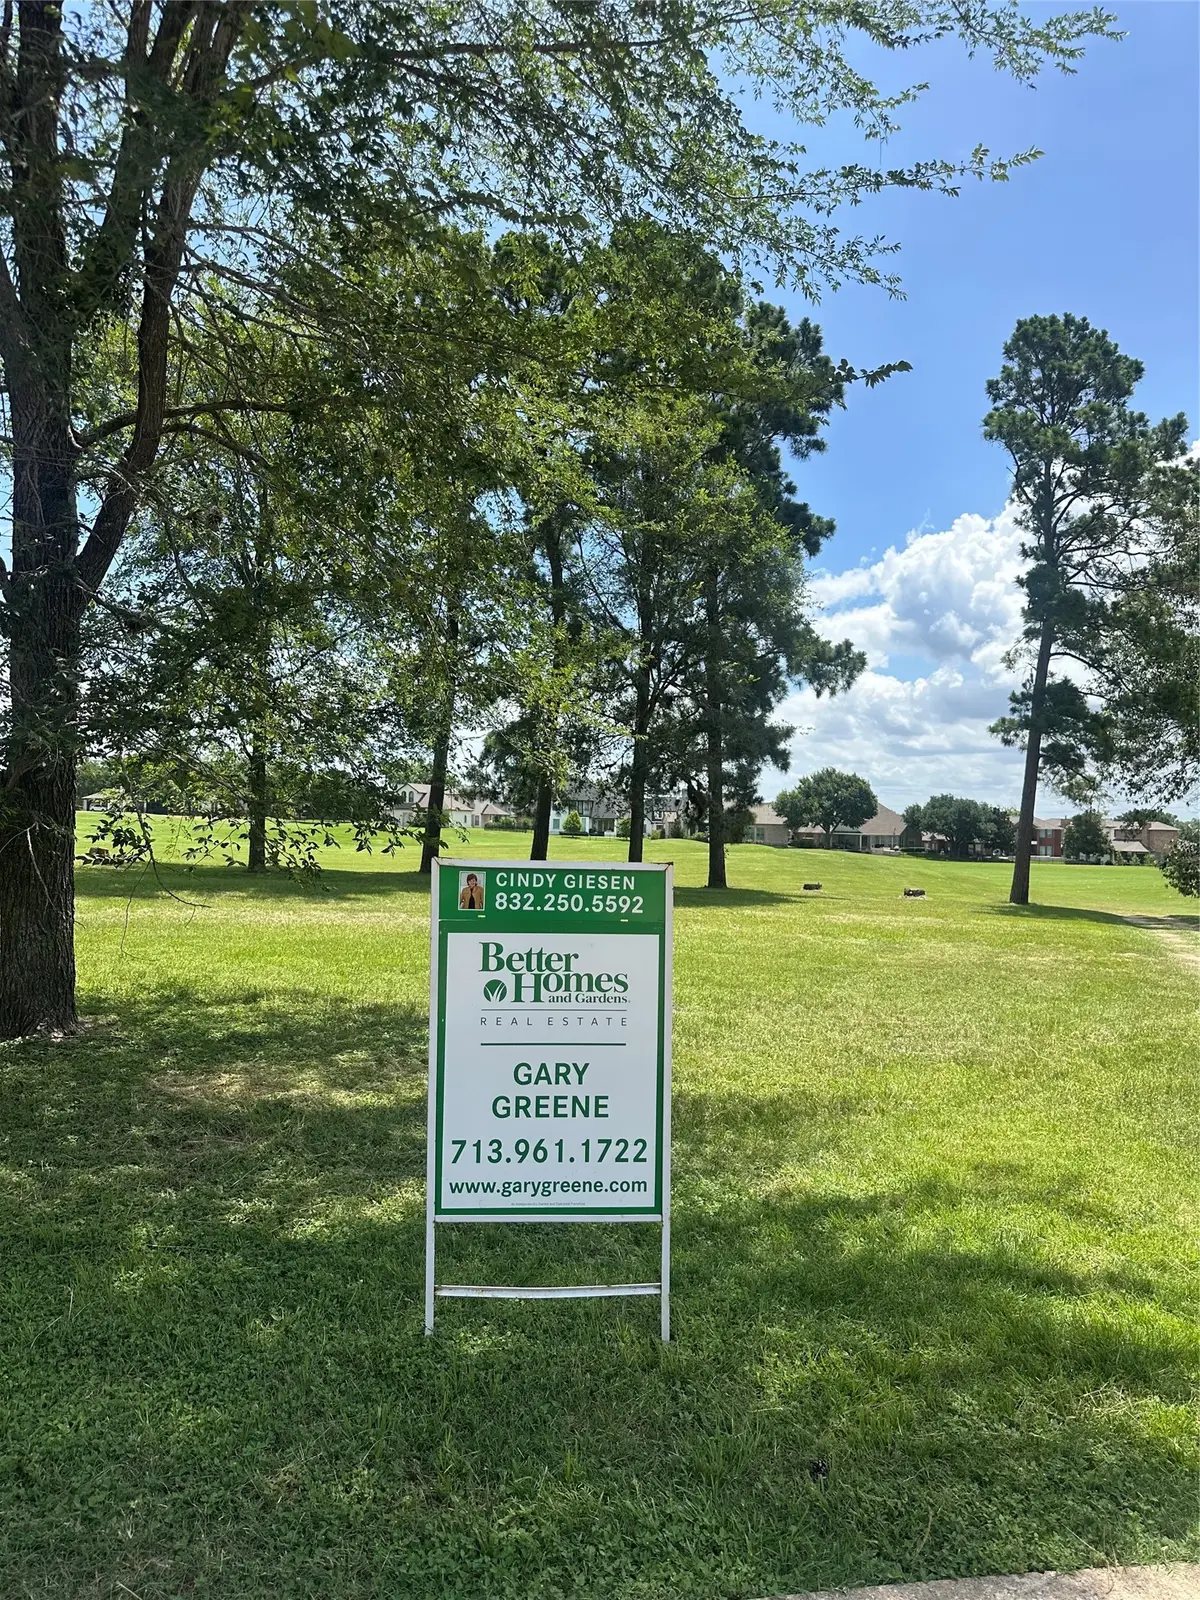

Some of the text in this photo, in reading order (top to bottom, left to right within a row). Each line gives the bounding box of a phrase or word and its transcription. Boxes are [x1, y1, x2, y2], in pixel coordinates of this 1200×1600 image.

[495, 873, 635, 890] CINDY GIESEN
[495, 892, 644, 914] 832.250.5592
[478, 942, 579, 973] Better
[511, 972, 629, 1003] Homes
[548, 993, 572, 1003] and
[480, 1017, 627, 1026] REAL ESTATE
[513, 1062, 590, 1085] GARY
[491, 1095, 609, 1118] GREENE
[451, 1138, 648, 1164] 713.961.1722
[449, 1179, 648, 1197] www.garygreene.com
